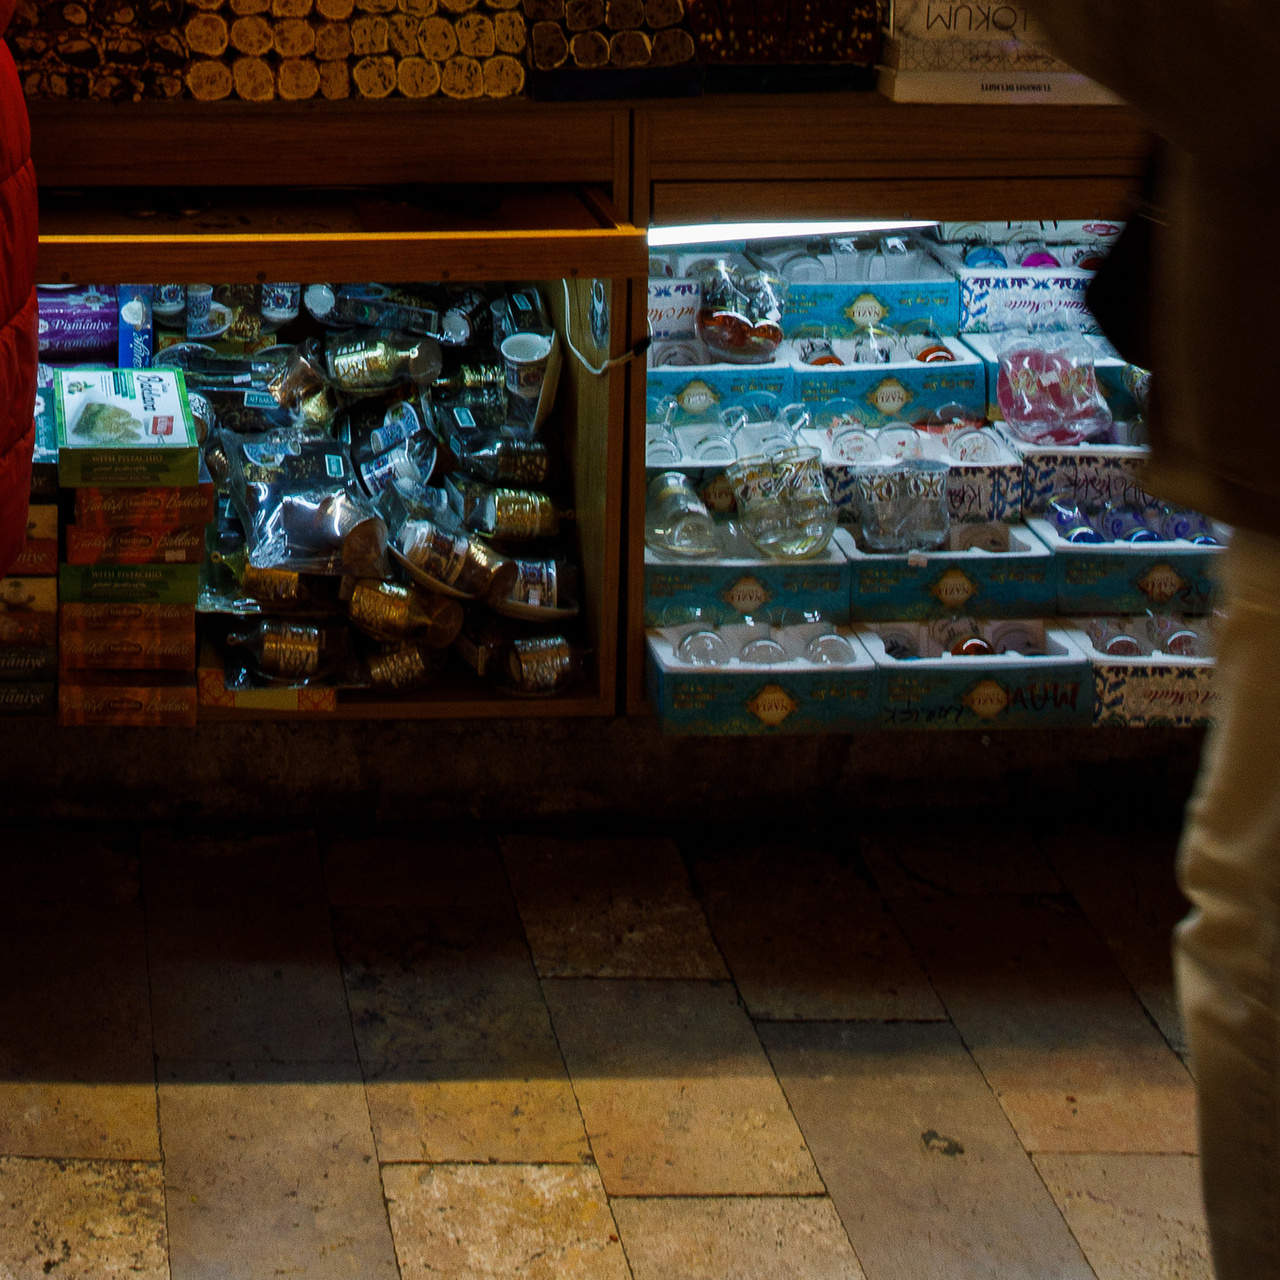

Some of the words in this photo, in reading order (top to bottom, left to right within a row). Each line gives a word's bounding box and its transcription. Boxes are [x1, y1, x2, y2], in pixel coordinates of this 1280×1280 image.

[927, 5, 1028, 31] LOKUM
[91, 455, 115, 463] WITH
[91, 571, 115, 579] WITH
